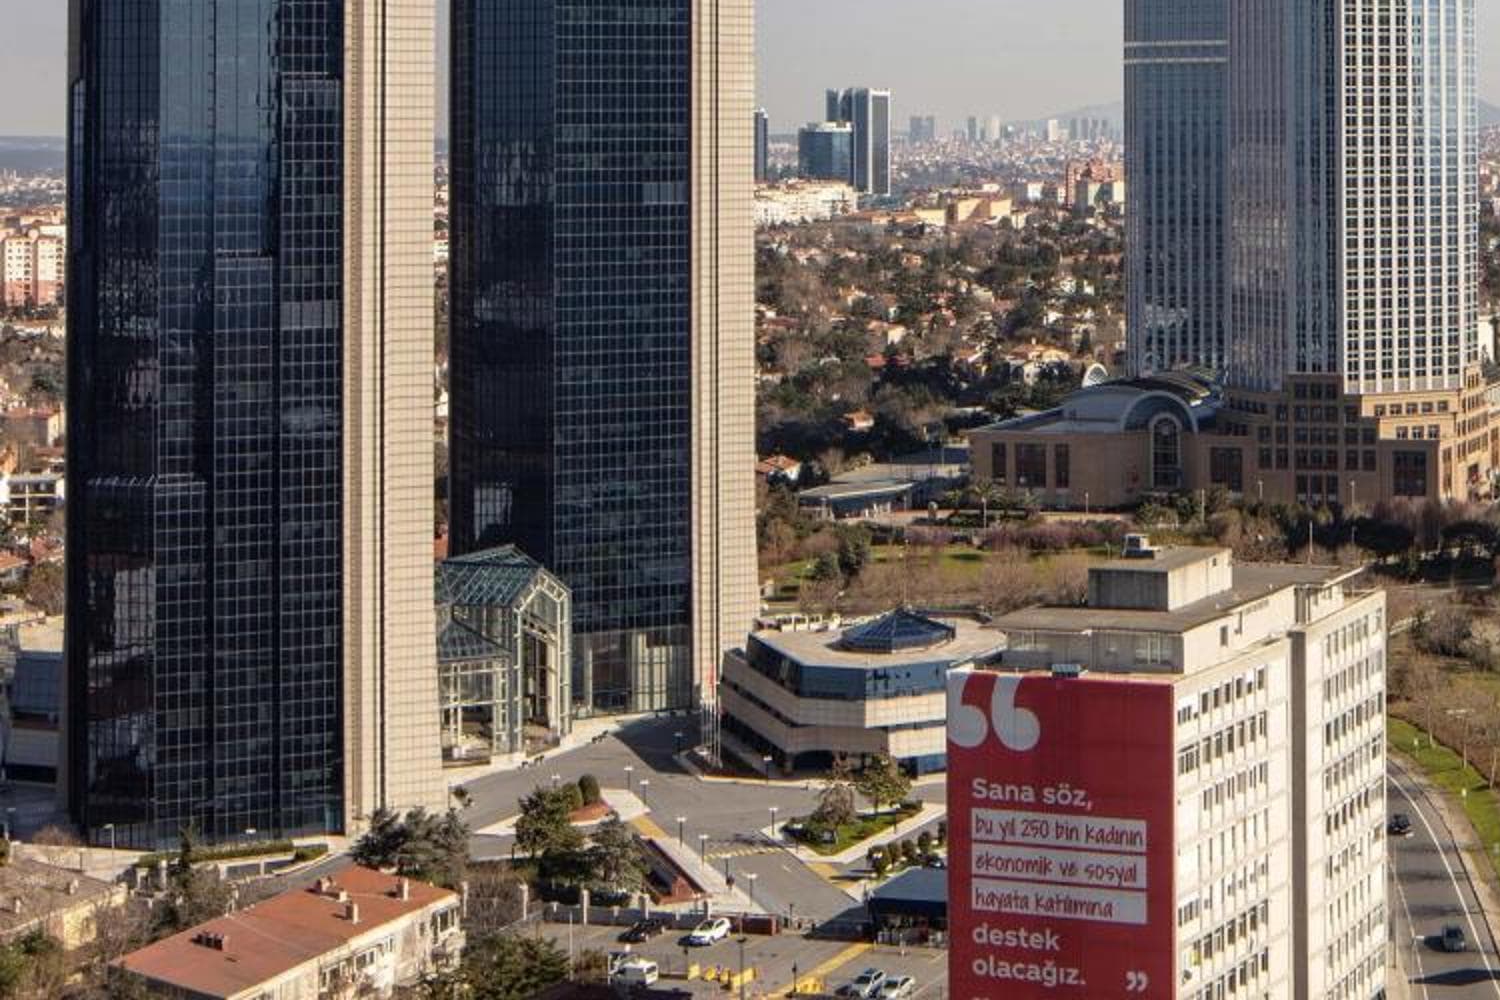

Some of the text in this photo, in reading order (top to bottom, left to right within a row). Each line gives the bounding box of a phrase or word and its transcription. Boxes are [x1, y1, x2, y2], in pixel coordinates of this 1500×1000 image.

[972, 777, 1093, 810] Sana söz,
[975, 813, 993, 835] bu
[1021, 818, 1050, 839] 250
[1055, 821, 1079, 842] bin
[975, 851, 1137, 888] ekonomik ve sosyal
[975, 887, 1030, 910] hayata
[972, 921, 1061, 951] destek
[972, 955, 1087, 987] olacağız.
